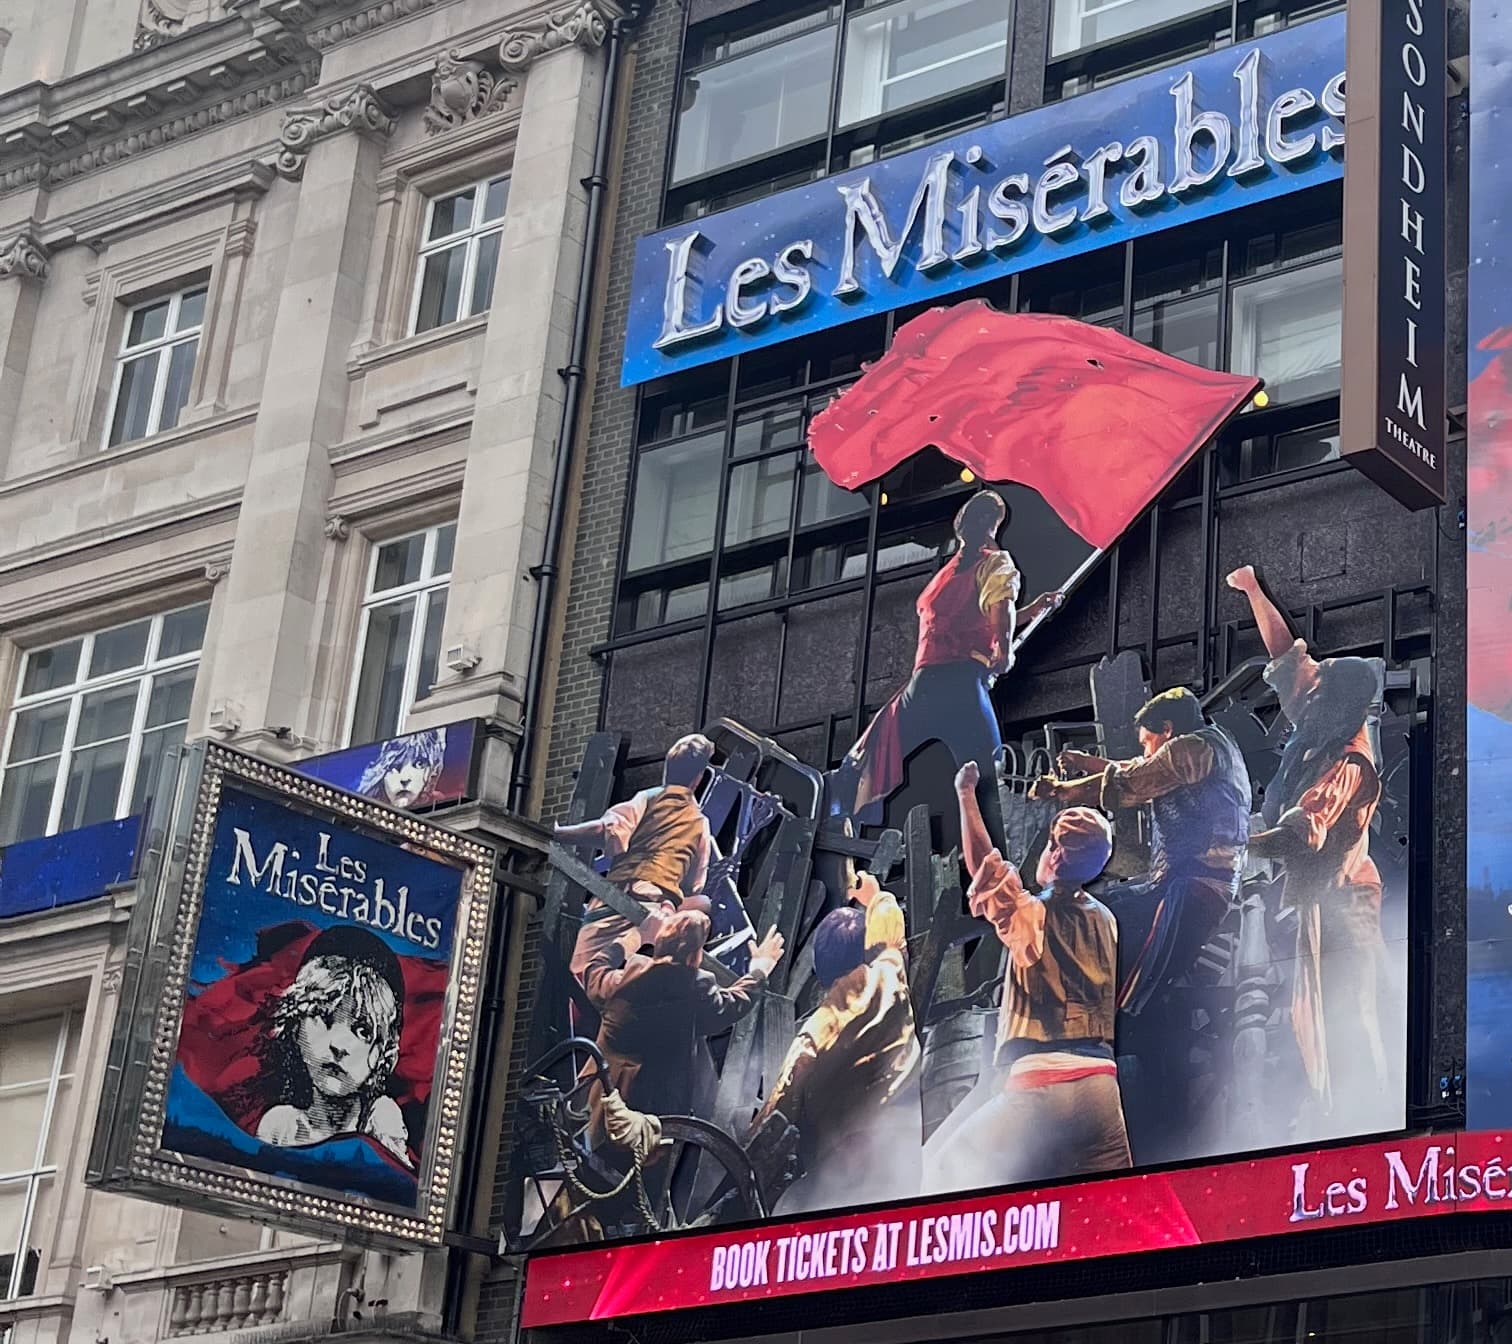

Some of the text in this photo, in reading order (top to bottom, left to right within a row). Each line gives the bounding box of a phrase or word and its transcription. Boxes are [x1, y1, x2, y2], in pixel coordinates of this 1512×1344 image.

[652, 231, 813, 351] Les
[1385, 417, 1437, 470] THEATRE
[226, 827, 442, 949] Misérables
[315, 832, 367, 884] Les
[1289, 1162, 1368, 1223] Les
[710, 1200, 1061, 1292] BOOK TICKETS AT LESMIS.COM
